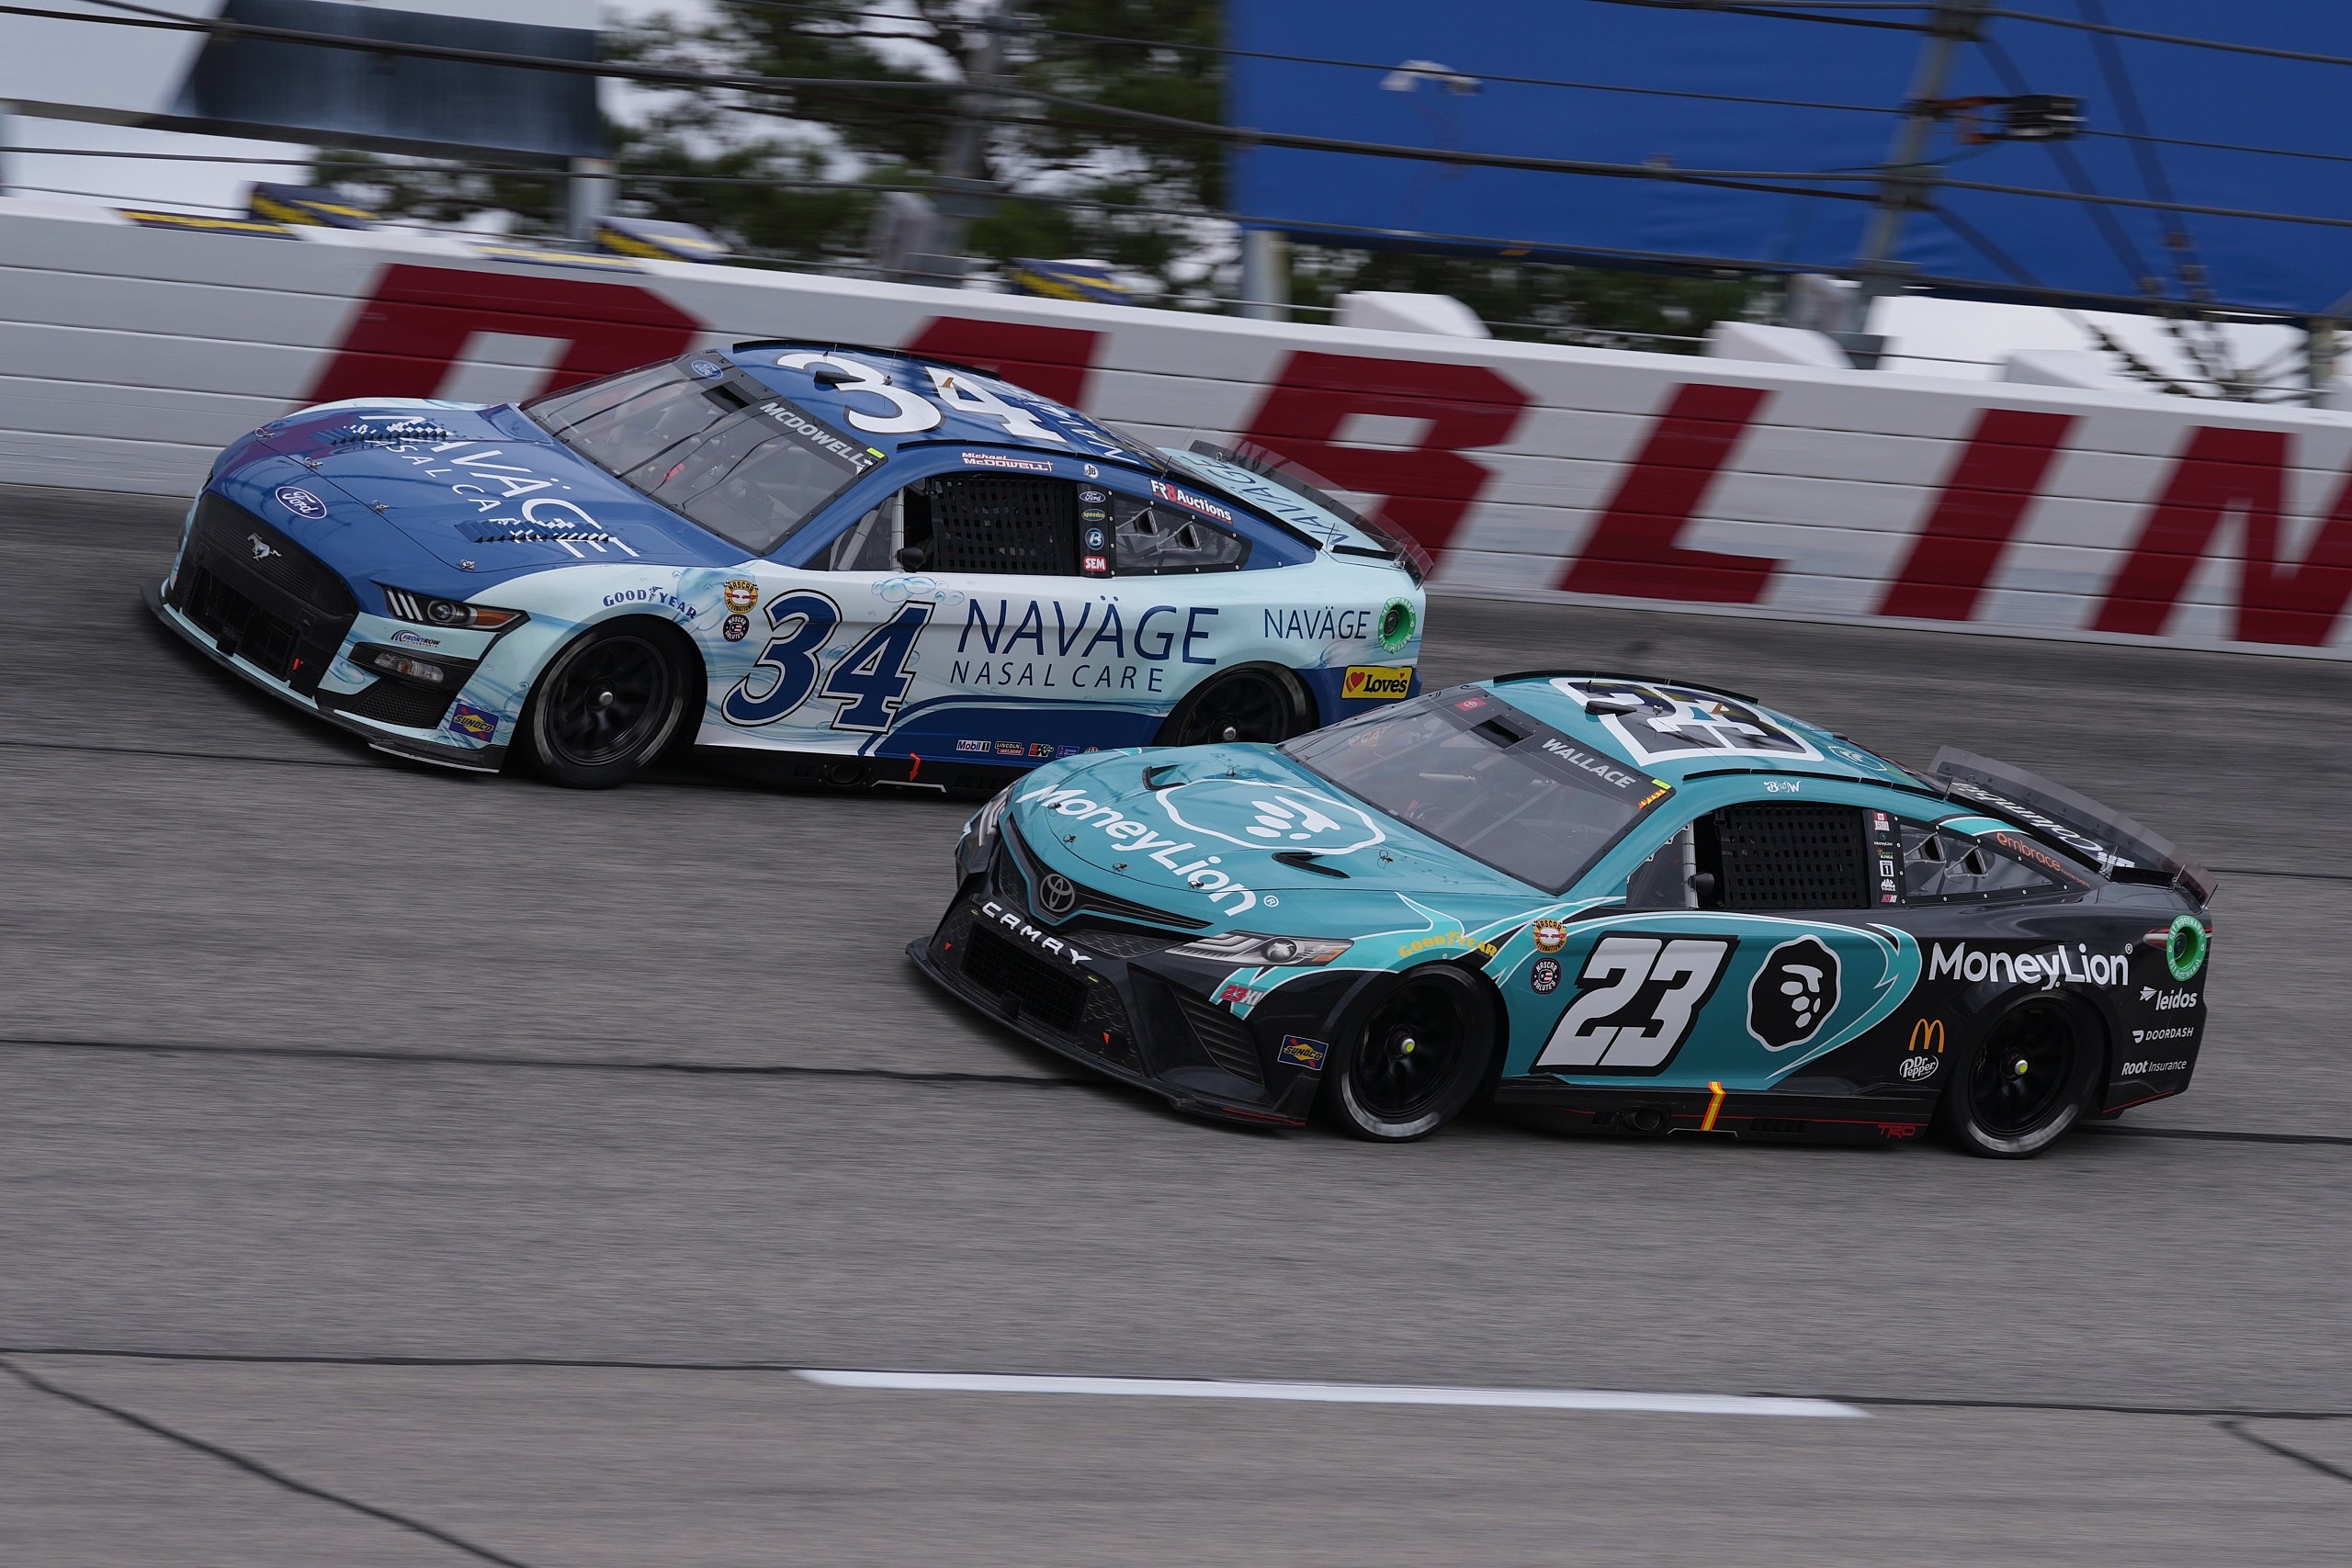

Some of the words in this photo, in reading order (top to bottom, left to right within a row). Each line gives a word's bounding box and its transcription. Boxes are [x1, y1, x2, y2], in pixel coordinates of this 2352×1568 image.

[776, 352, 1069, 445] 34
[759, 401, 865, 466] MCDOWELL
[281, 491, 319, 513] Ford
[1084, 491, 1102, 502] Ford
[1085, 558, 1106, 570] SEM
[728, 581, 755, 592] NASCAR
[957, 594, 1220, 666] NAVÄGE
[1263, 605, 1372, 640] NAVÄGE
[719, 589, 935, 735] 34
[950, 660, 1056, 688] NASAL
[1071, 664, 1165, 694] CARE
[454, 715, 494, 731] SUNOCO
[956, 740, 981, 751] Mobil
[996, 741, 1022, 750] LINCOLN
[1542, 738, 1636, 788] WALLACE
[1996, 831, 2062, 872] embrace
[982, 901, 1093, 965] CAMRY
[1535, 919, 1563, 931] NASCAR
[1535, 961, 1558, 973] NASCAR
[1536, 937, 1731, 1069] 23
[2155, 987, 2199, 1010] leidos
[2145, 1026, 2195, 1041] DOORDASH
[1285, 1046, 1323, 1060] SUNOCO
[1914, 1055, 1928, 1068] Dr
[1903, 1057, 1936, 1078] Pepper
[2148, 1060, 2188, 1073] Insurance
[1877, 1123, 1917, 1139] TRD
